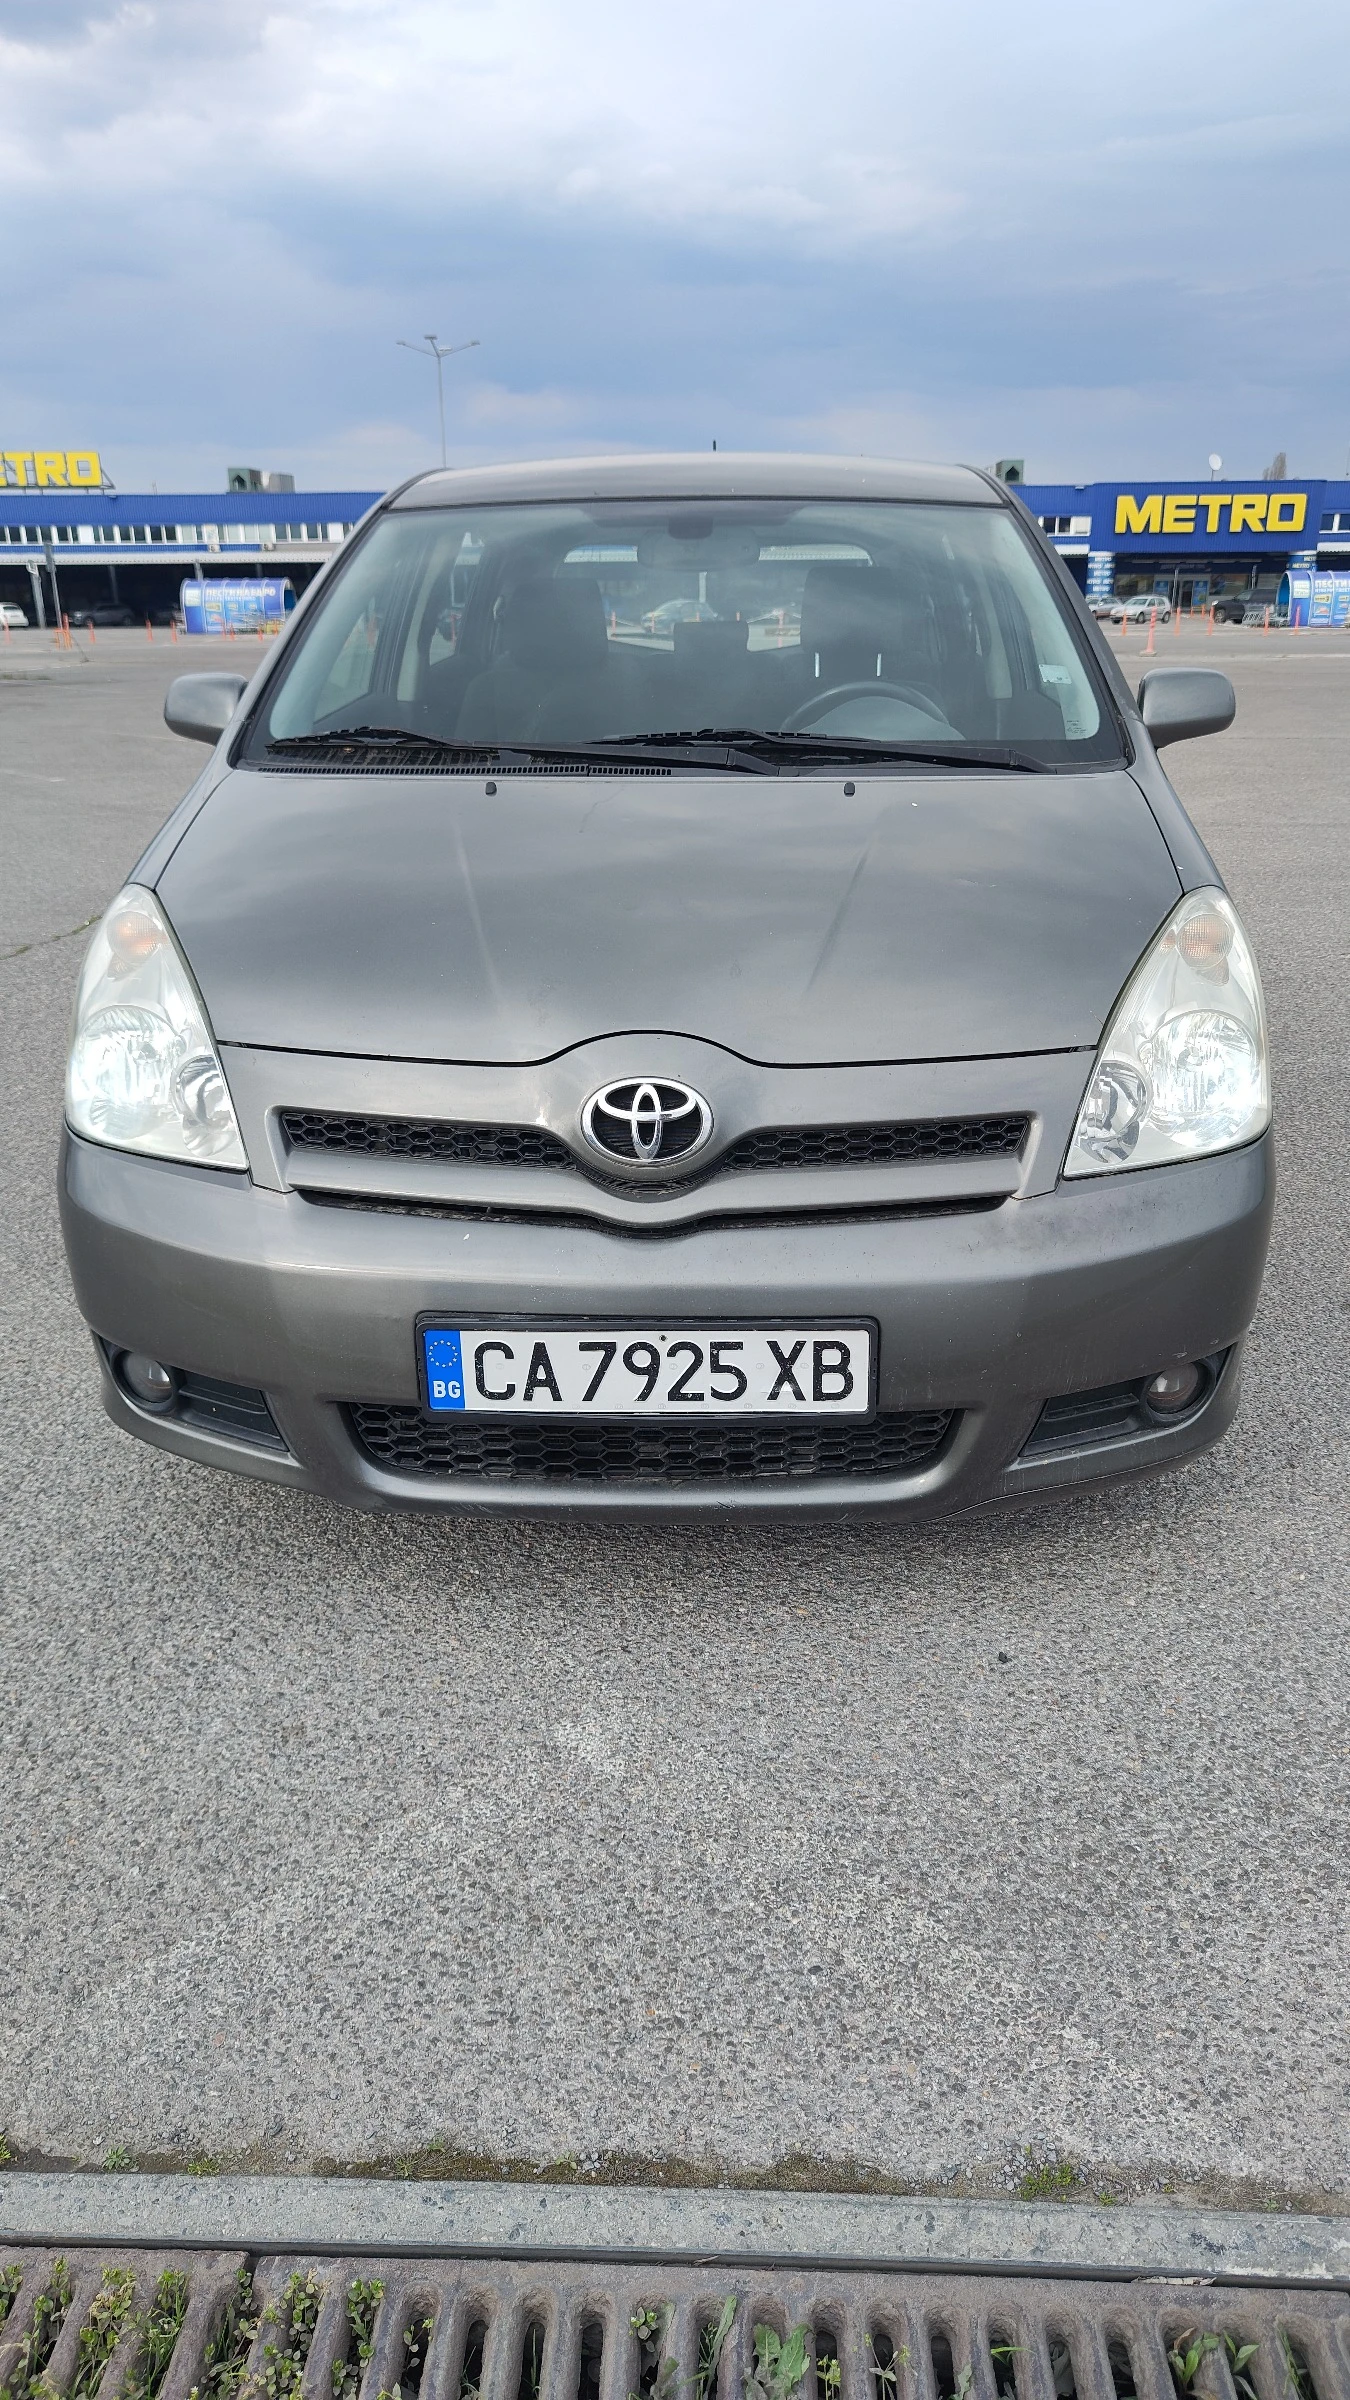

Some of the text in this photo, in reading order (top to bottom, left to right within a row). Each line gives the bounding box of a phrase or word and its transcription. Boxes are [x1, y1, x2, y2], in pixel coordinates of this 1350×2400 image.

[0, 451, 102, 487] TRO
[1114, 493, 1308, 534] METRO
[432, 1380, 461, 1399] BG
[474, 1340, 854, 1402] CA 7925 XB
